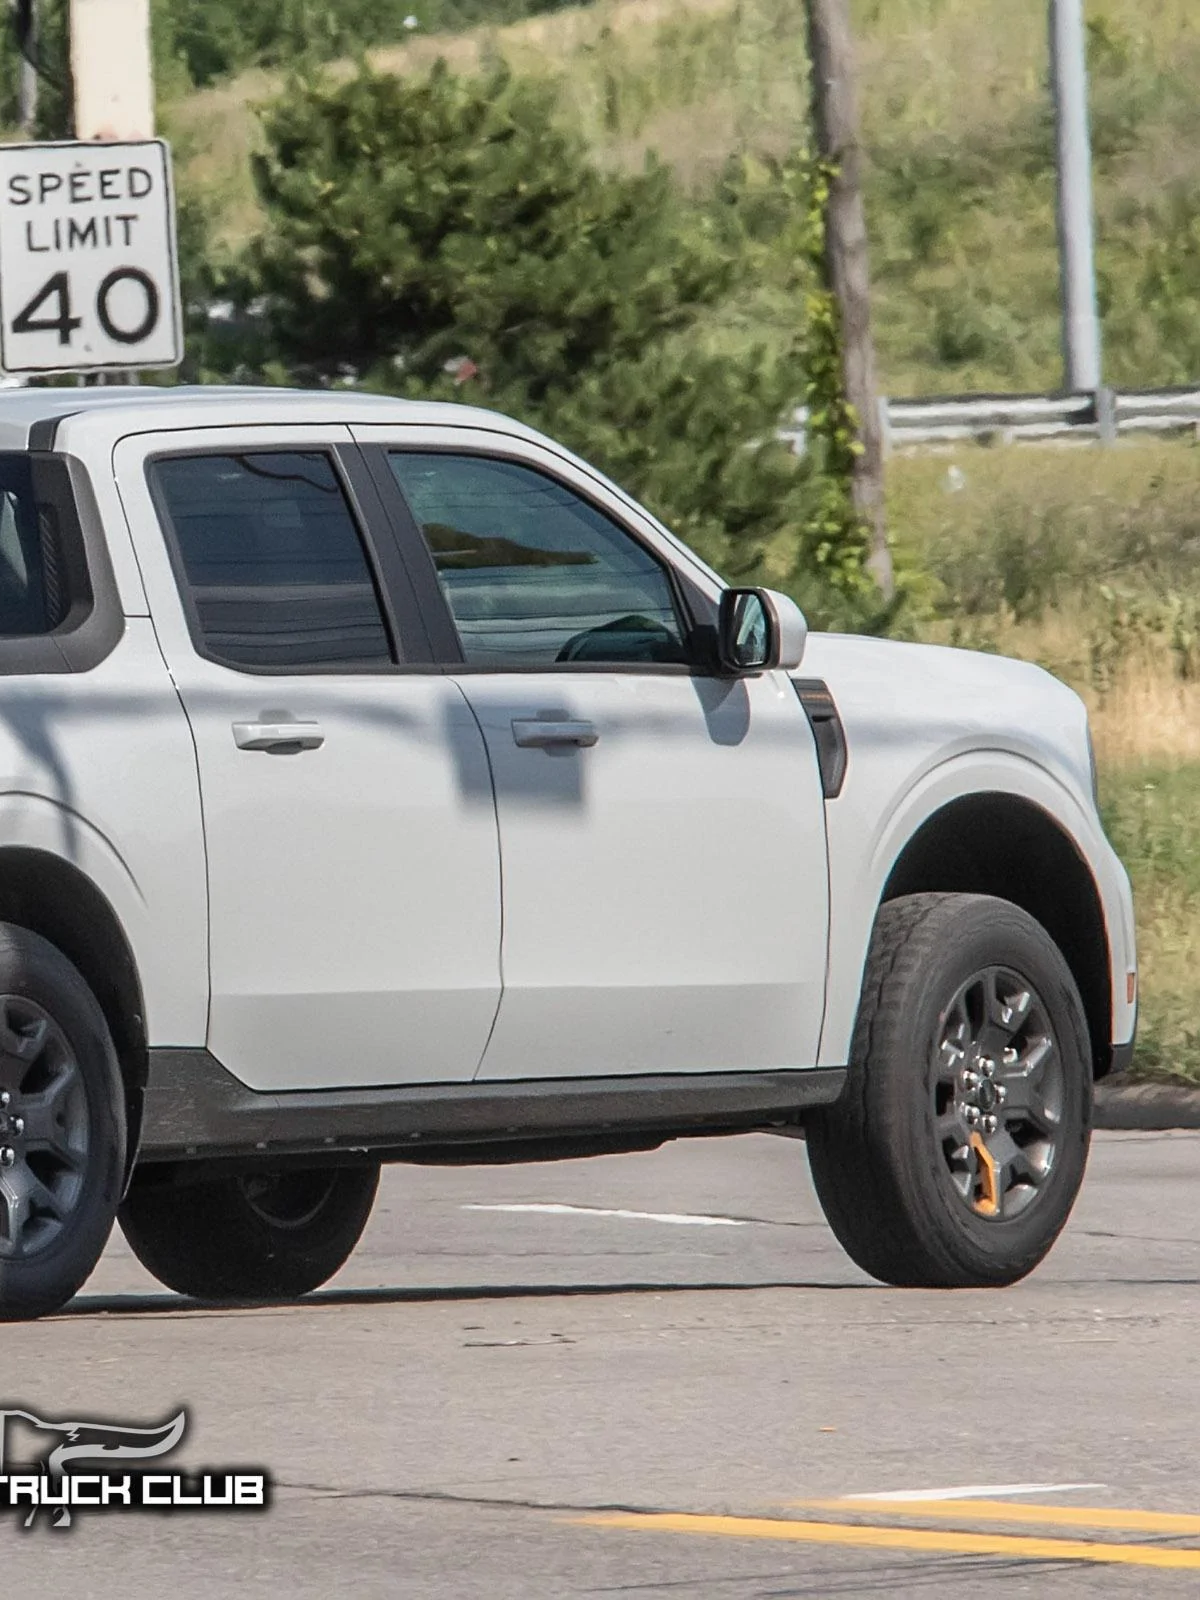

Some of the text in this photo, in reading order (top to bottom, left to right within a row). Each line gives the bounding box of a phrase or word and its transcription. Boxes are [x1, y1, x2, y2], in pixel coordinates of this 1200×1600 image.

[8, 166, 154, 205] SPEED
[26, 214, 139, 252] LIMIT
[11, 265, 159, 345] 40
